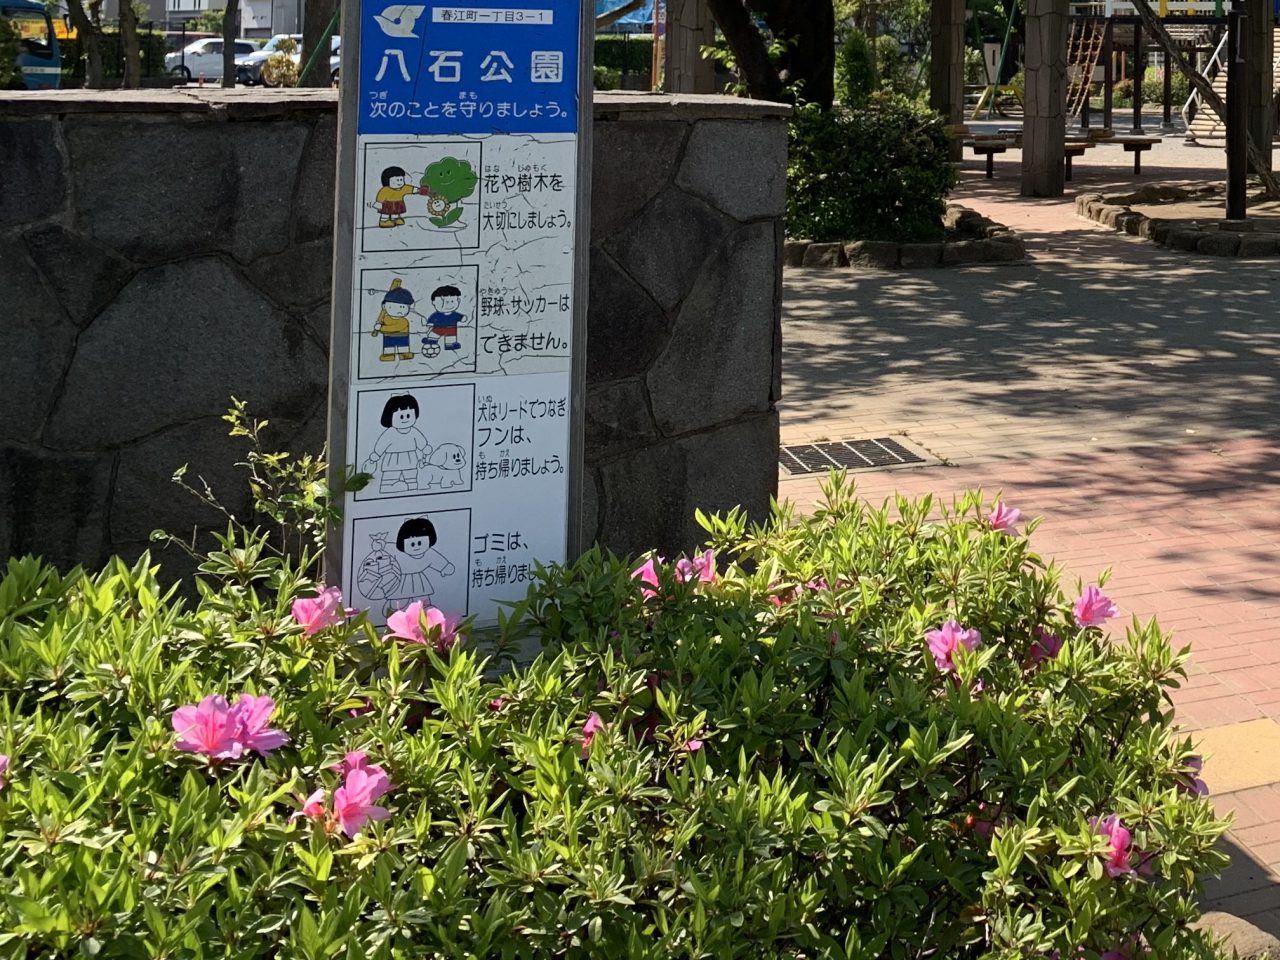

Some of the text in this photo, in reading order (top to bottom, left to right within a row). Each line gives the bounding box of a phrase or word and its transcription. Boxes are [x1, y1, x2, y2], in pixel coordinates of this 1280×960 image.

[374, 48, 564, 83] 八石公園
[369, 101, 567, 118] 次のことを守りましょう。
[484, 173, 563, 193] 花や樹木を
[483, 210, 571, 230] 大切にしましょう。
[481, 294, 570, 316] 野球、サッカーは
[480, 331, 568, 353] できません。
[478, 397, 566, 422] 犬はリードでつなぎ
[478, 425, 531, 447] フンは、
[475, 455, 564, 480] 持ち帰りましょう。
[474, 531, 528, 554] ゴミは、
